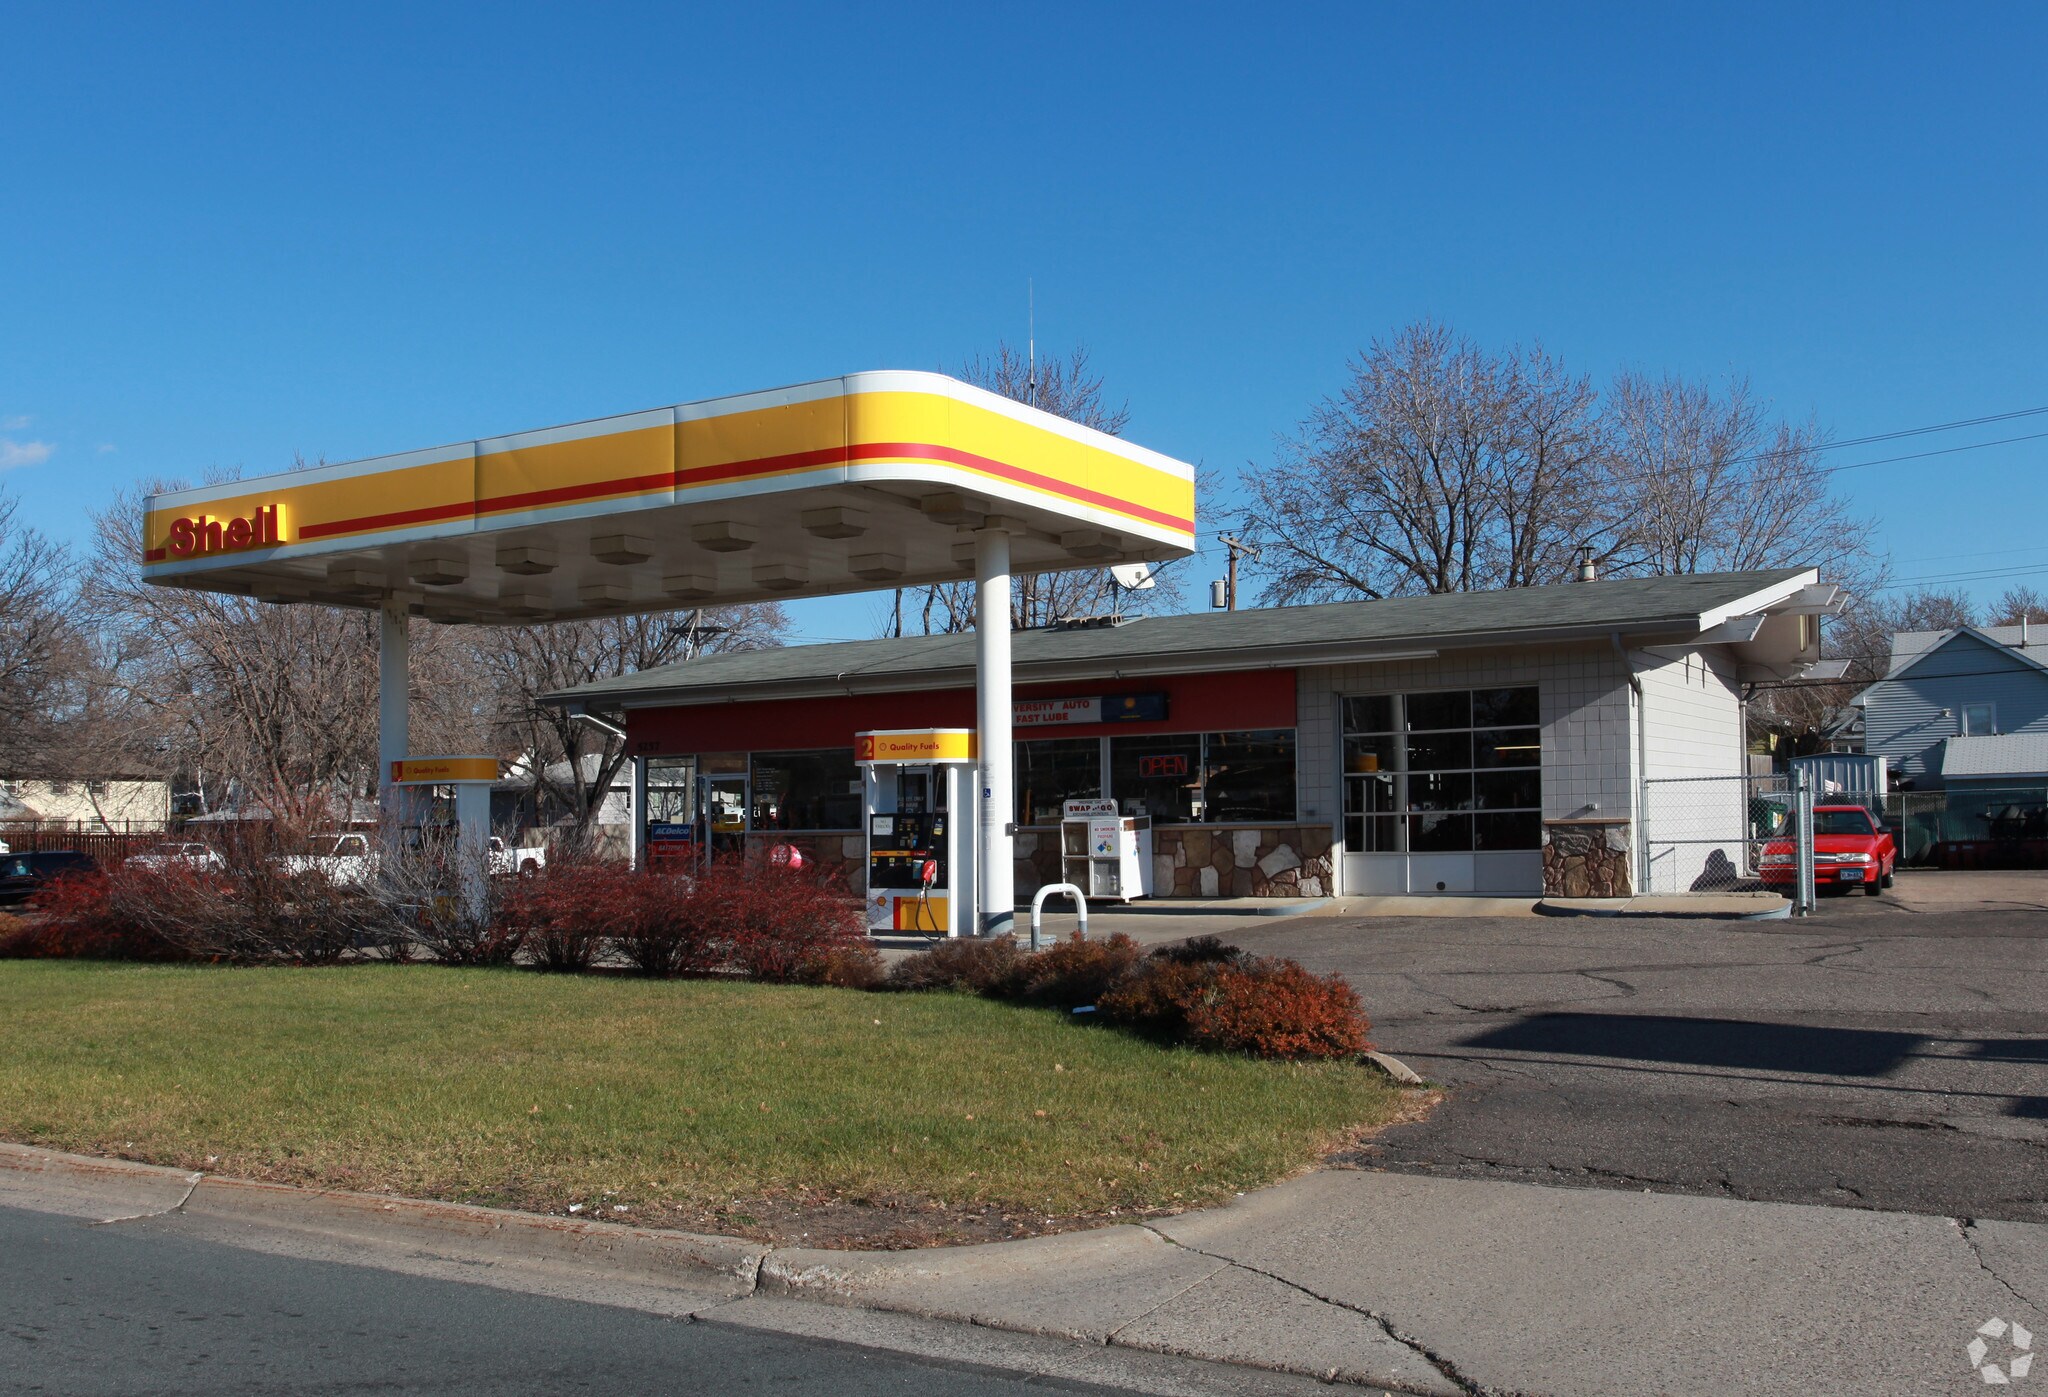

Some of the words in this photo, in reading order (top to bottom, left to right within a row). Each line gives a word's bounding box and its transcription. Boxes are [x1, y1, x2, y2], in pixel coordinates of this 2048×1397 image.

[169, 504, 278, 556] Shell
[1014, 702, 1054, 712] VERSITY
[1062, 700, 1090, 710] AUTO
[1016, 714, 1040, 723] FAST
[1043, 712, 1069, 722] LUBE
[862, 739, 873, 757] 2
[890, 743, 918, 752] Quality
[920, 742, 939, 750] Fuels
[413, 767, 433, 775] Quality
[1140, 755, 1186, 776] OPEN
[655, 827, 689, 835] ACDelco
